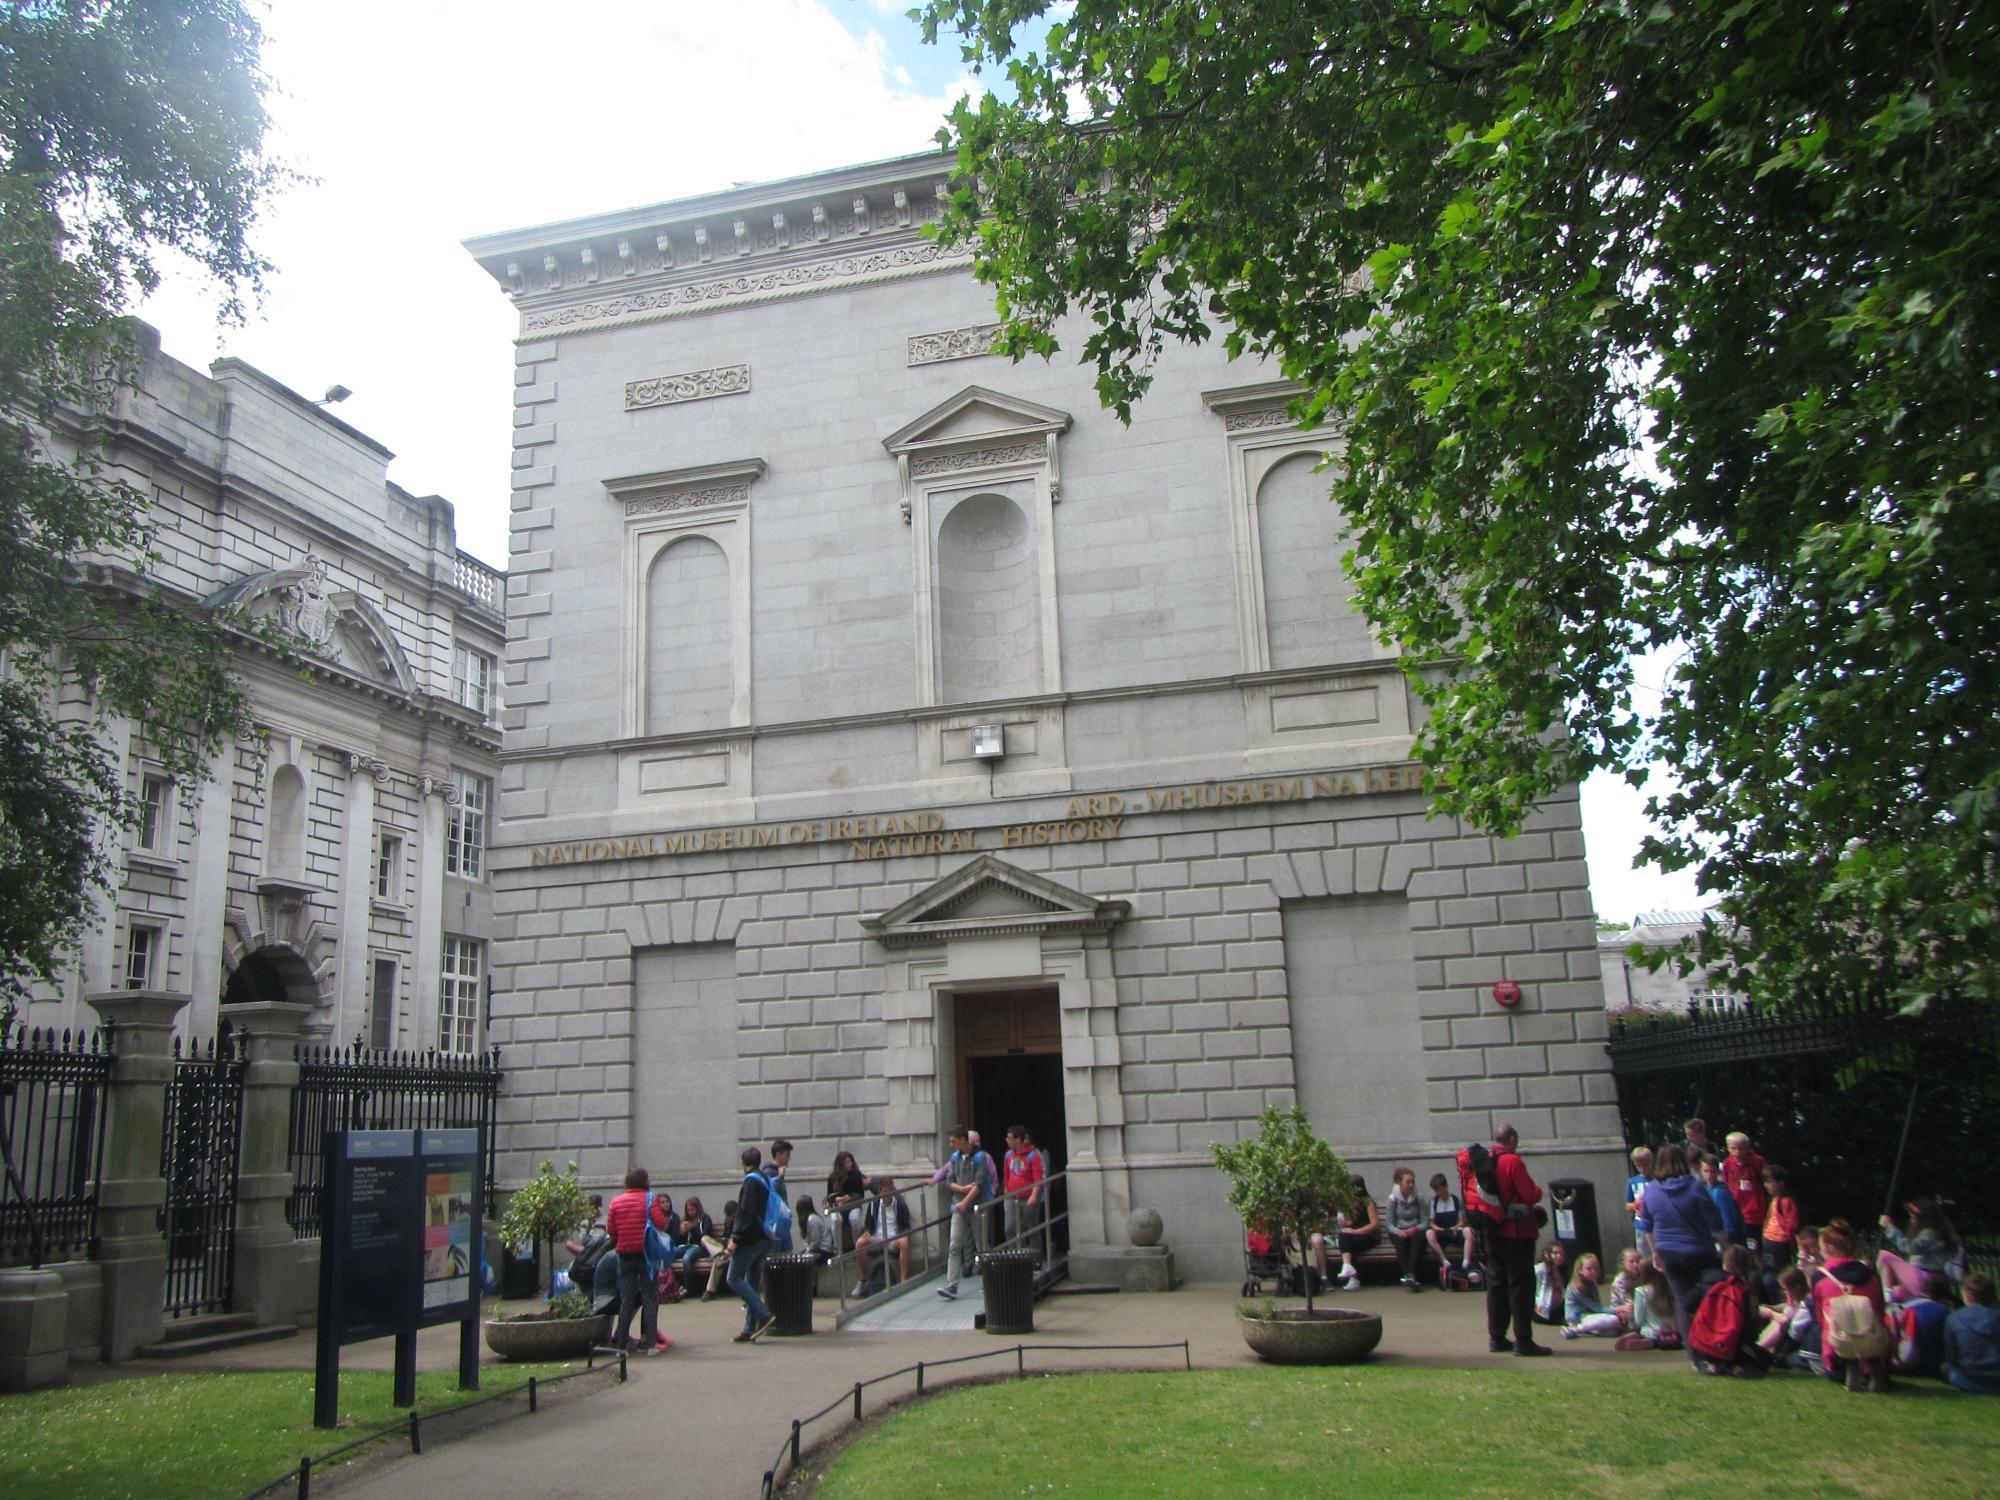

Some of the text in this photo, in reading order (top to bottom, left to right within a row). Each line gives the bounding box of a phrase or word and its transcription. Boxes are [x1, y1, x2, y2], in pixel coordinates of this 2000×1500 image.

[1311, 773, 1356, 797] NA
[530, 811, 944, 866] NATIONAL MUSEUM OF IRELAND
[849, 817, 1124, 861] NATURAL HISTORY
